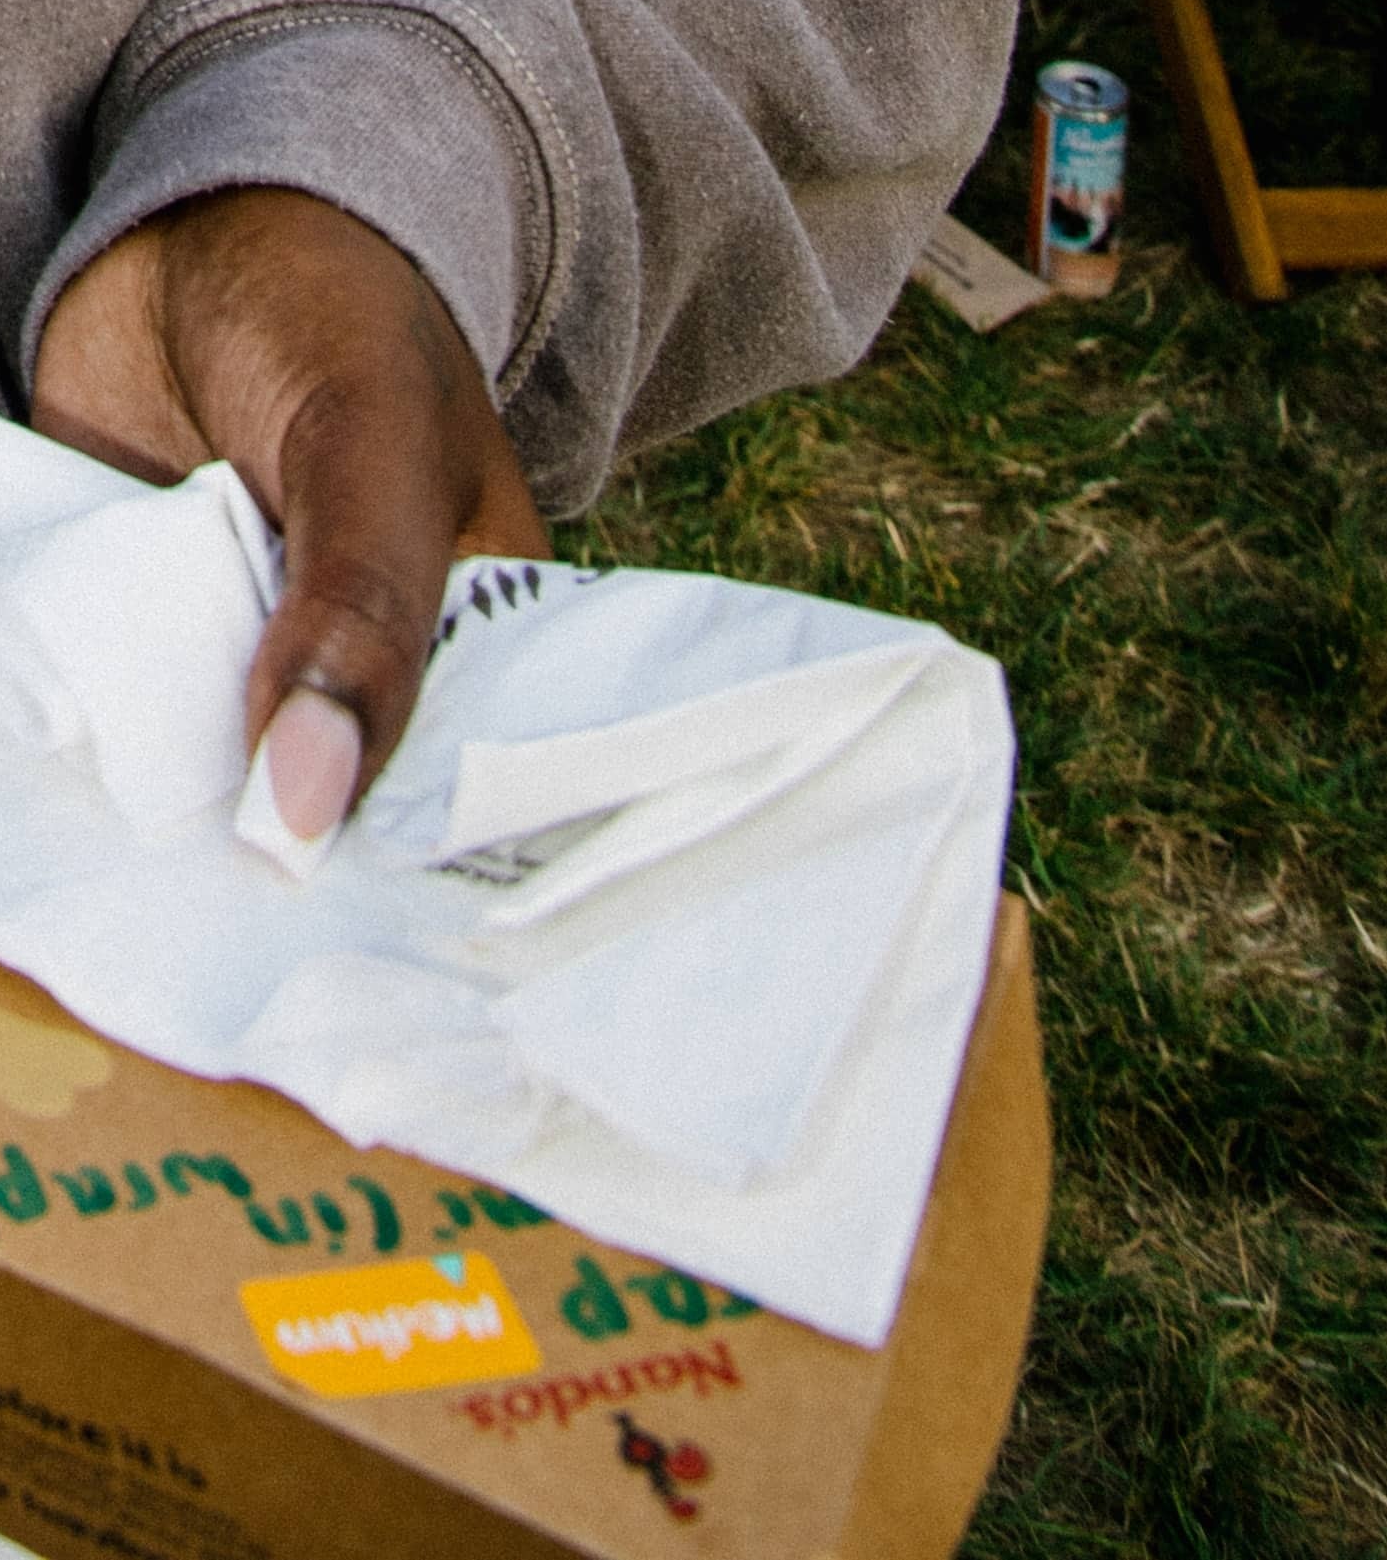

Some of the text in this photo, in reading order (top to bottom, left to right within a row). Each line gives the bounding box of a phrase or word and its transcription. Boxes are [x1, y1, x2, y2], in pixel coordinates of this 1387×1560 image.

[247, 1175, 403, 1254] (in
[274, 1292, 508, 1360] Medium
[462, 1340, 744, 1439] Nando's
